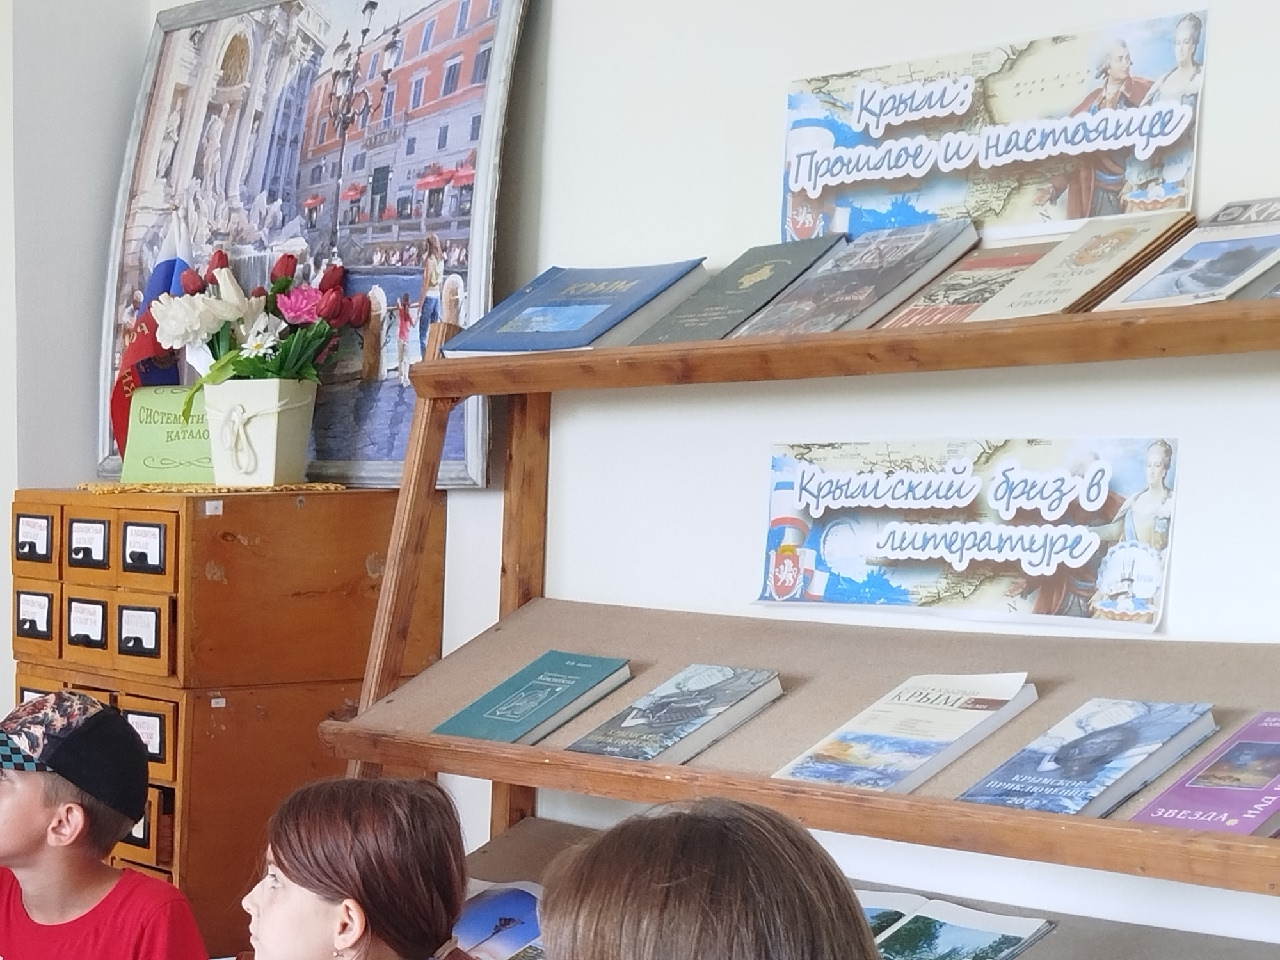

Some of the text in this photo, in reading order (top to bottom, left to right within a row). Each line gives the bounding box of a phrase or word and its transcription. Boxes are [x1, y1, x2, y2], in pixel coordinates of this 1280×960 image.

[857, 81, 971, 130] Крым:
[793, 107, 1184, 186] Прошлое и настоящее
[139, 405, 208, 425] СИСТЕМТИ
[165, 429, 210, 443] КАТАЛО
[797, 465, 1106, 514] Крымский бриз в
[875, 527, 1092, 568] литературе
[890, 690, 964, 708] КРЫМ
[1012, 775, 1087, 788] КРЫМСКОЕ
[1150, 795, 1278, 822] ЗВЕЗДА НАД
